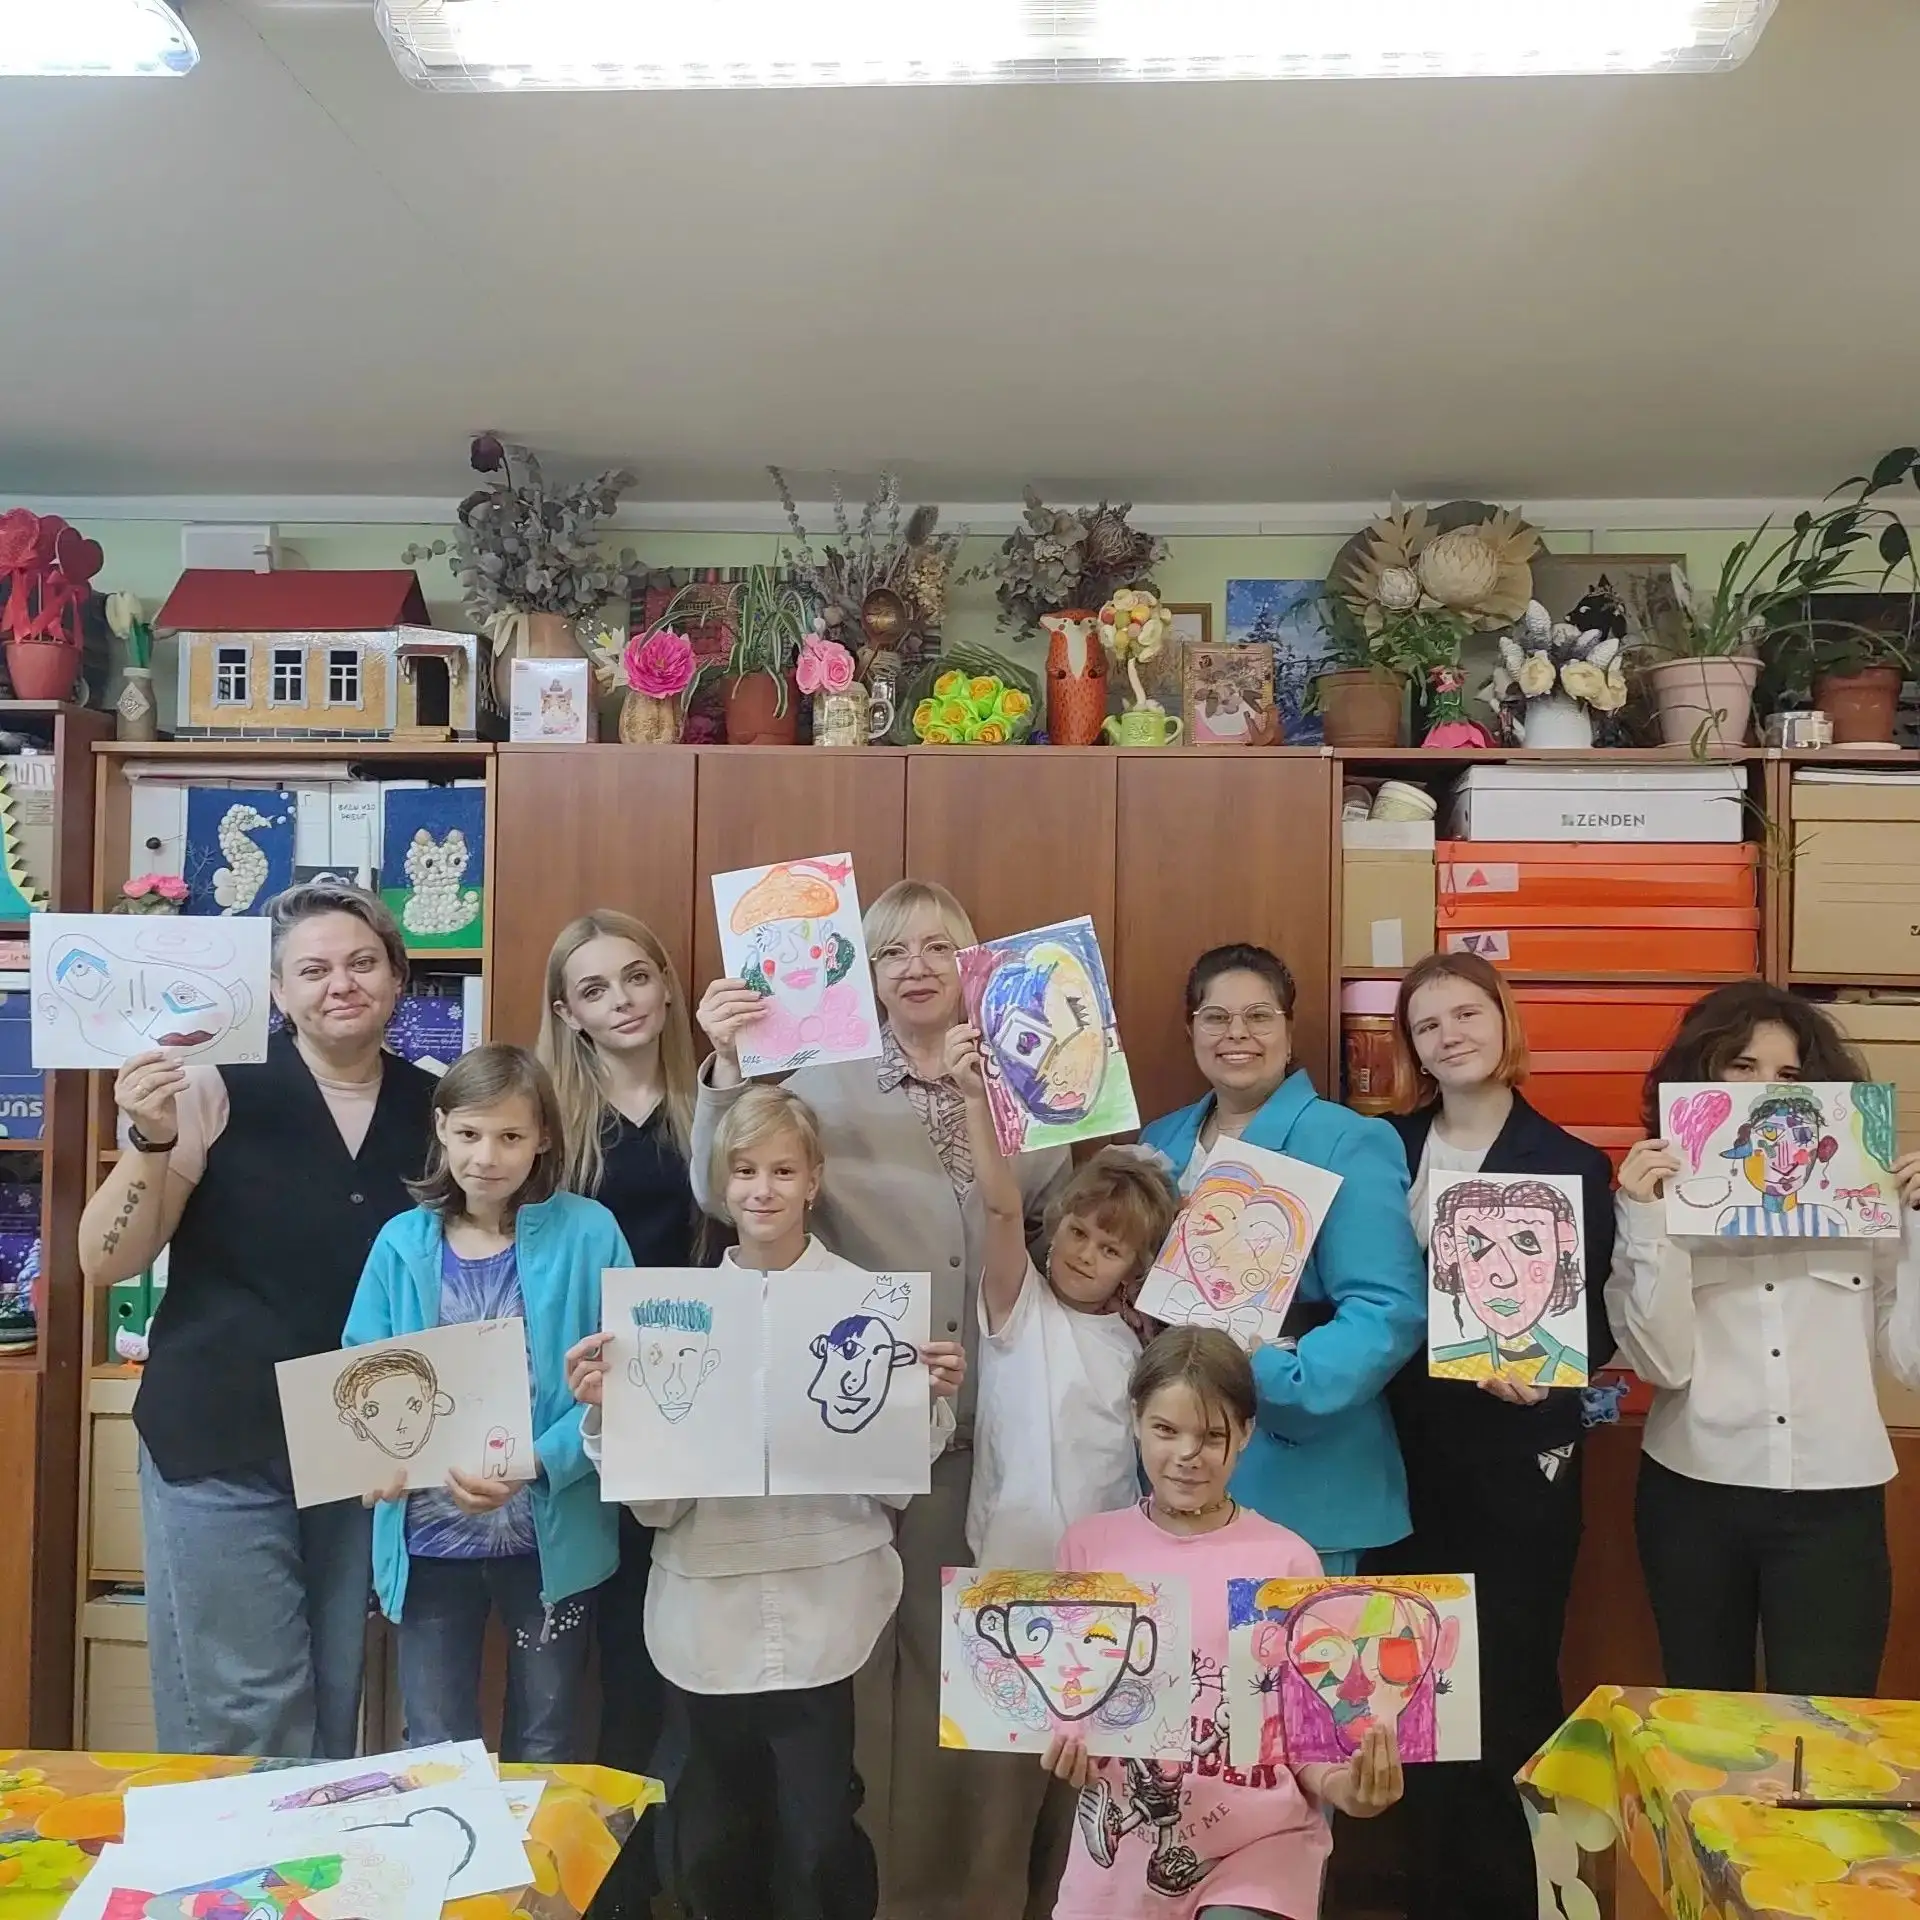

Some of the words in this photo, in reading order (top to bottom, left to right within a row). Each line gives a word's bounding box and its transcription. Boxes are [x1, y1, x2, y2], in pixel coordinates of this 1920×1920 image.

[1577, 813, 1646, 827] ZENDEN
[1177, 1823, 1198, 1843] AT
[1201, 1802, 1231, 1830] ME
